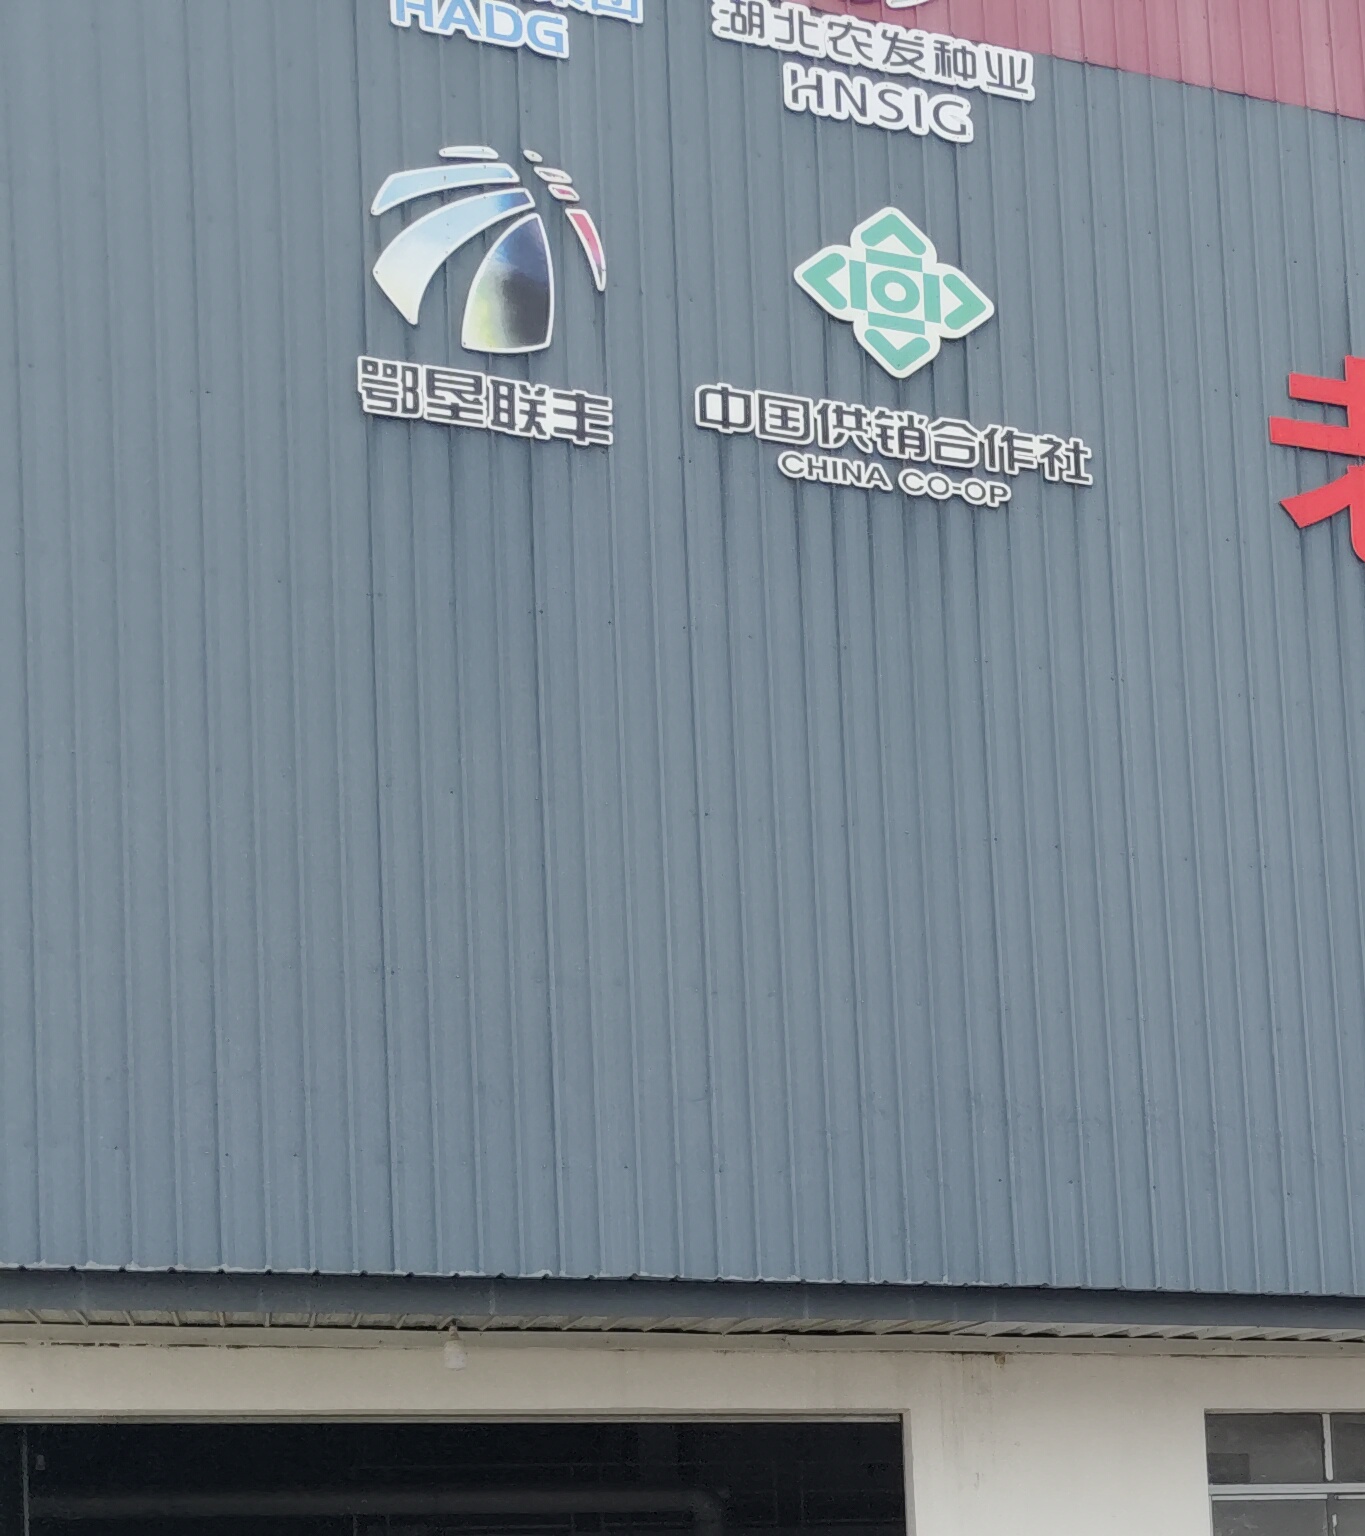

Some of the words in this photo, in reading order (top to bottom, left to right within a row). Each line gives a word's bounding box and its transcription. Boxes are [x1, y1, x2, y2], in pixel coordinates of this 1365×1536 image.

[395, 0, 565, 53] HADG
[718, 0, 1030, 95] 湖北农发种业
[790, 68, 968, 137] HNSIG
[360, 358, 611, 443] 鄂垦联丰
[698, 385, 1092, 484] 中国供销合作社
[780, 453, 890, 489] CHINA
[901, 470, 1010, 505] CO-OP
